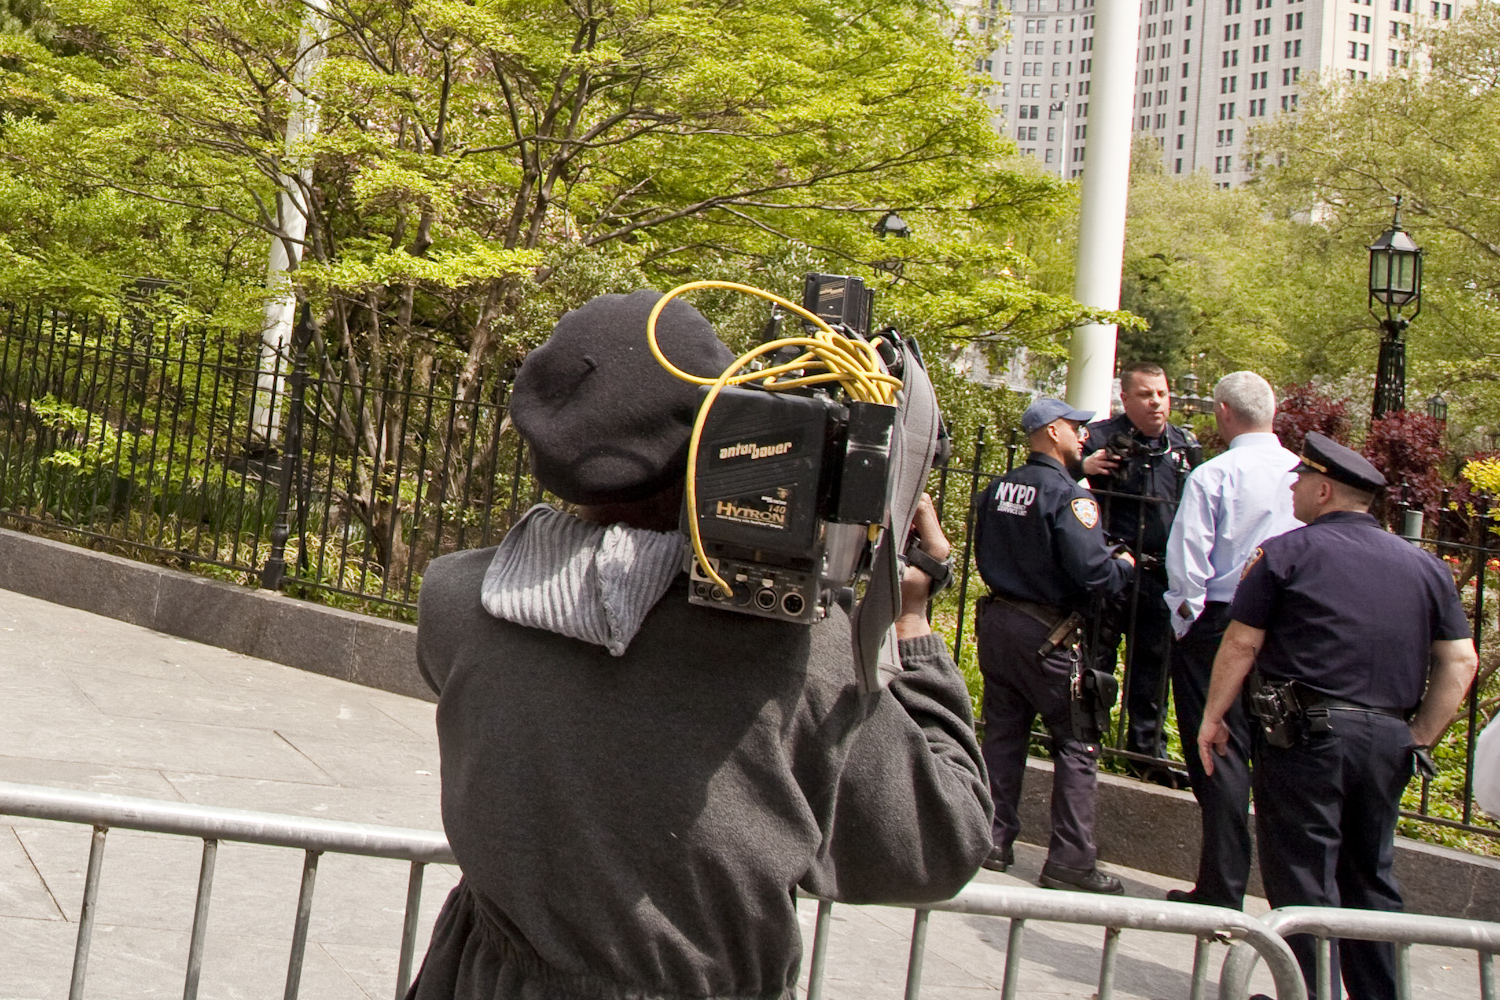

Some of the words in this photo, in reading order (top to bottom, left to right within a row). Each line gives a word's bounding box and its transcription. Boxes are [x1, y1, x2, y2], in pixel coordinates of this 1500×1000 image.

[995, 482, 1037, 506] NYPD
[716, 500, 785, 523] HYTRON
[768, 504, 787, 515] 140
